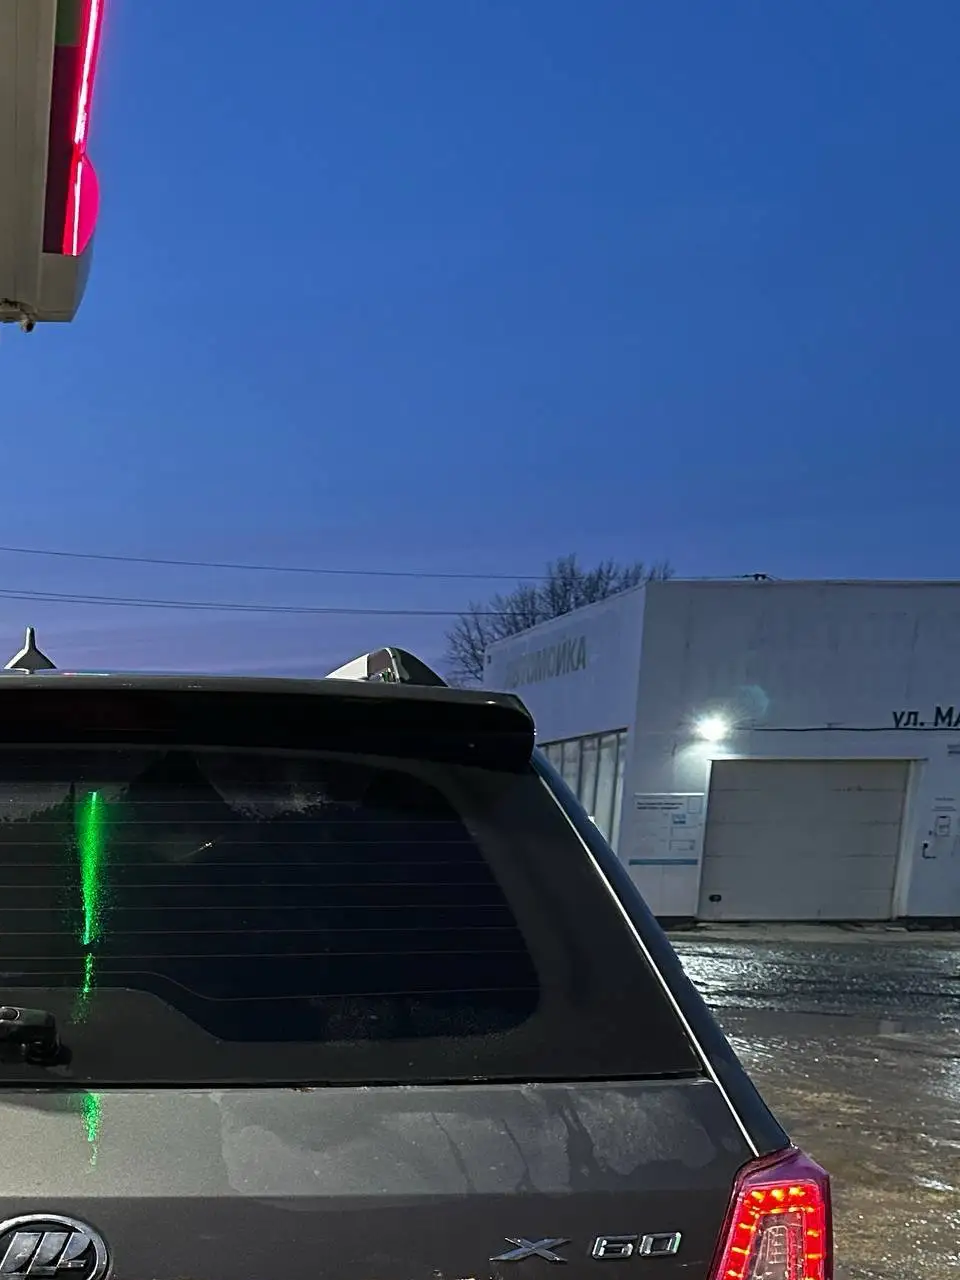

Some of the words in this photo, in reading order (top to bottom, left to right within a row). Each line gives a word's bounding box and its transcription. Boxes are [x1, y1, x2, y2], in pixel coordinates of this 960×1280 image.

[892, 710, 925, 728] ул.
[489, 1236, 572, 1262] X
[592, 1231, 683, 1260] 60
